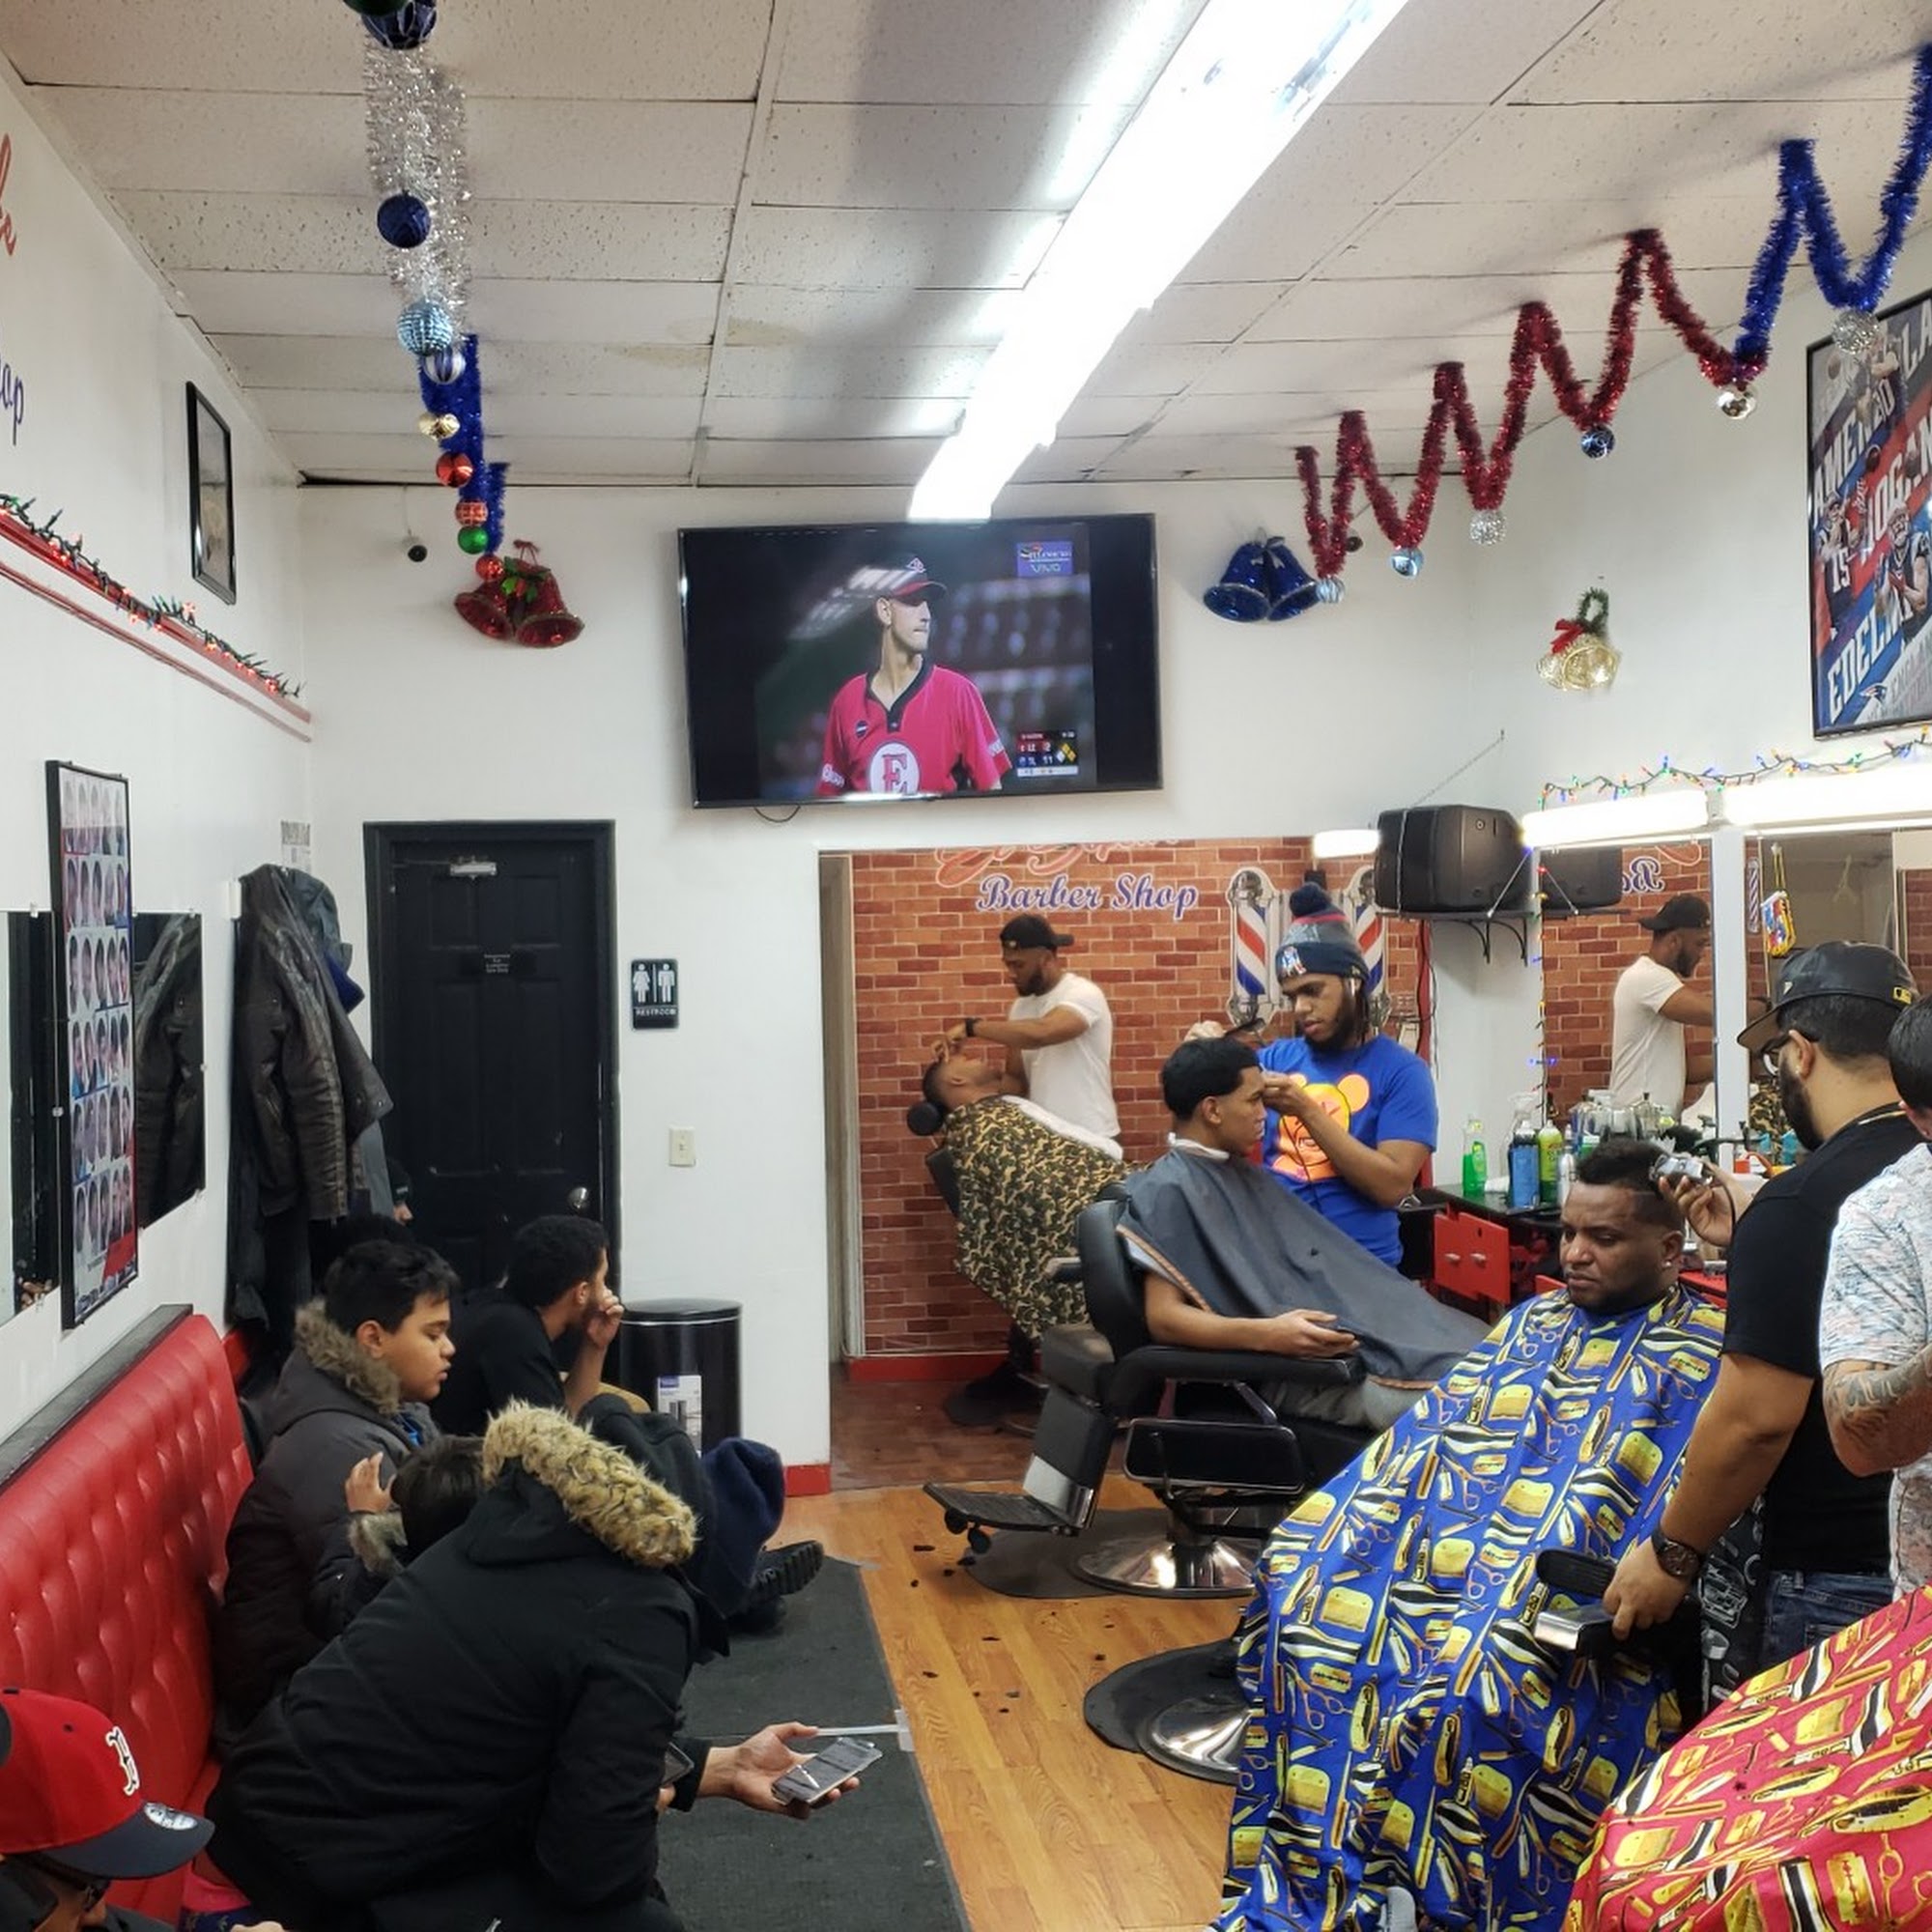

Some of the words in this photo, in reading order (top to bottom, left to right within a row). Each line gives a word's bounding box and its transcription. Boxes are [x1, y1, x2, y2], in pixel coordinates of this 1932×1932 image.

[882, 753, 907, 795] E
[977, 872, 1101, 912] Barber
[1112, 872, 1198, 921] Shop
[106, 1726, 139, 1796] B
